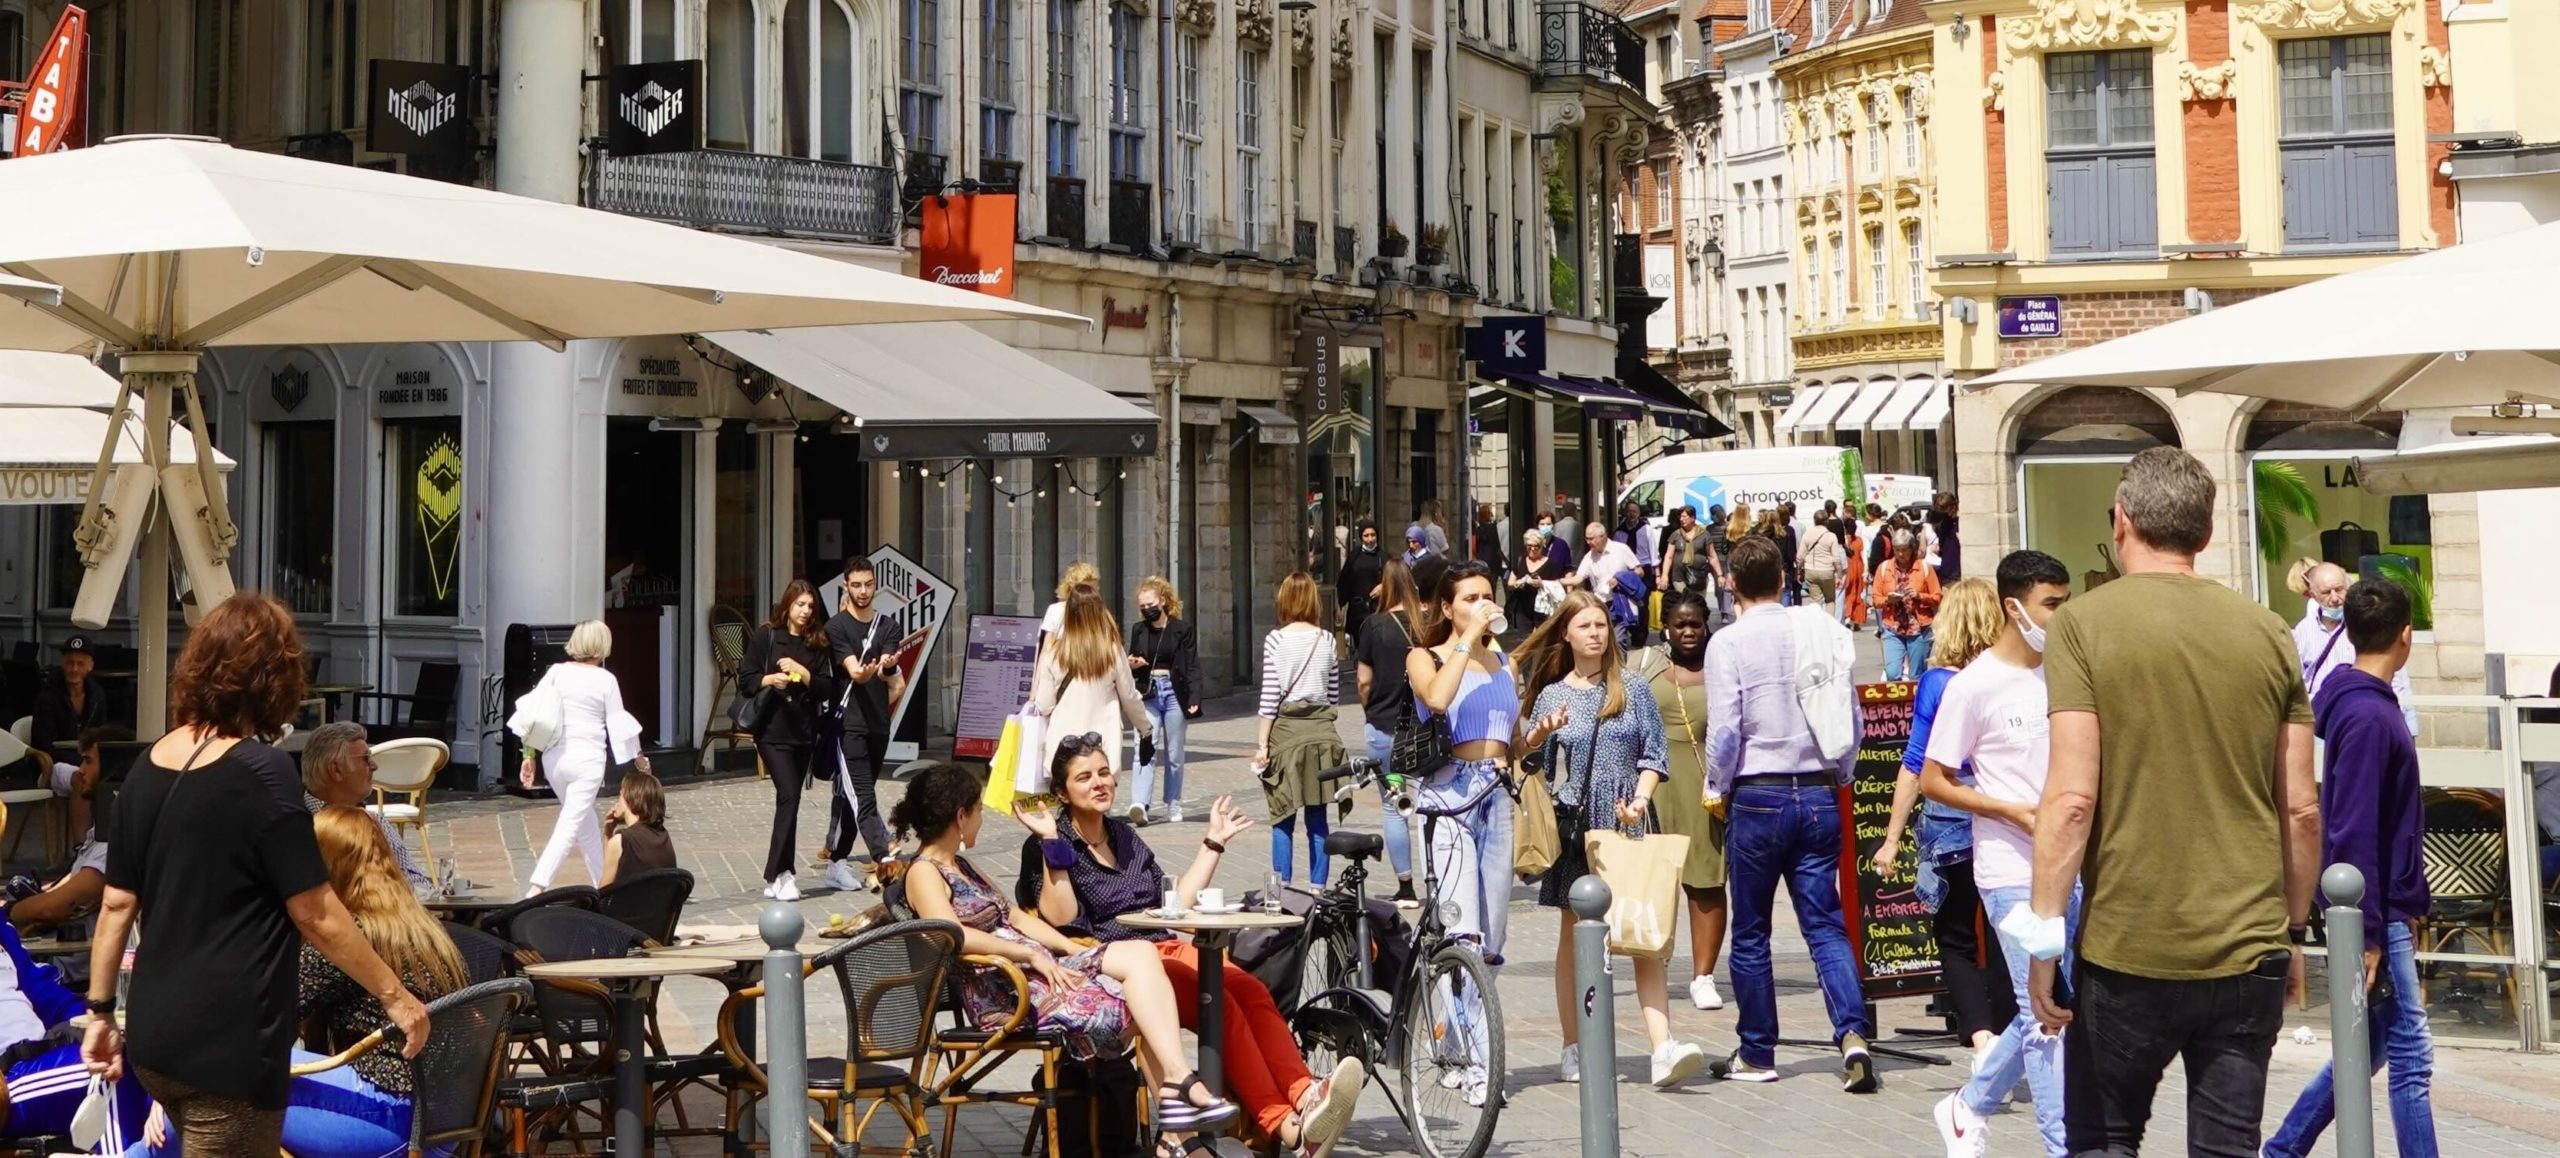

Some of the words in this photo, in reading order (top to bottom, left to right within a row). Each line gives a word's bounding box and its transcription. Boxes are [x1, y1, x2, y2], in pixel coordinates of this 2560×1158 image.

[25, 36, 70, 156] TABA
[388, 87, 456, 137] MEUNIER
[620, 88, 683, 137] MEUNIER
[932, 265, 1004, 285] Baccarat
[2027, 300, 2046, 309] Place
[2030, 322, 2055, 332] GAULLE
[1504, 329, 1527, 358] K
[640, 355, 681, 377] SPÉCIALITÉS
[1316, 335, 1327, 410] cresus
[396, 370, 430, 385] MAISON
[412, 388, 423, 403] EN
[426, 387, 448, 402] 1986
[622, 378, 646, 395] FRITES
[647, 379, 655, 396] ET
[656, 379, 698, 398] CROQUETTES
[1012, 431, 1047, 452] MEUNIER
[2, 470, 90, 500] VOUTE
[1734, 486, 1824, 505] chronopost
[1886, 683, 1908, 698] 30
[2009, 716, 2022, 728] 19
[1876, 802, 1894, 815] PLA
[1856, 821, 1888, 840] FORMU
[1875, 901, 1930, 918] EMPORTER
